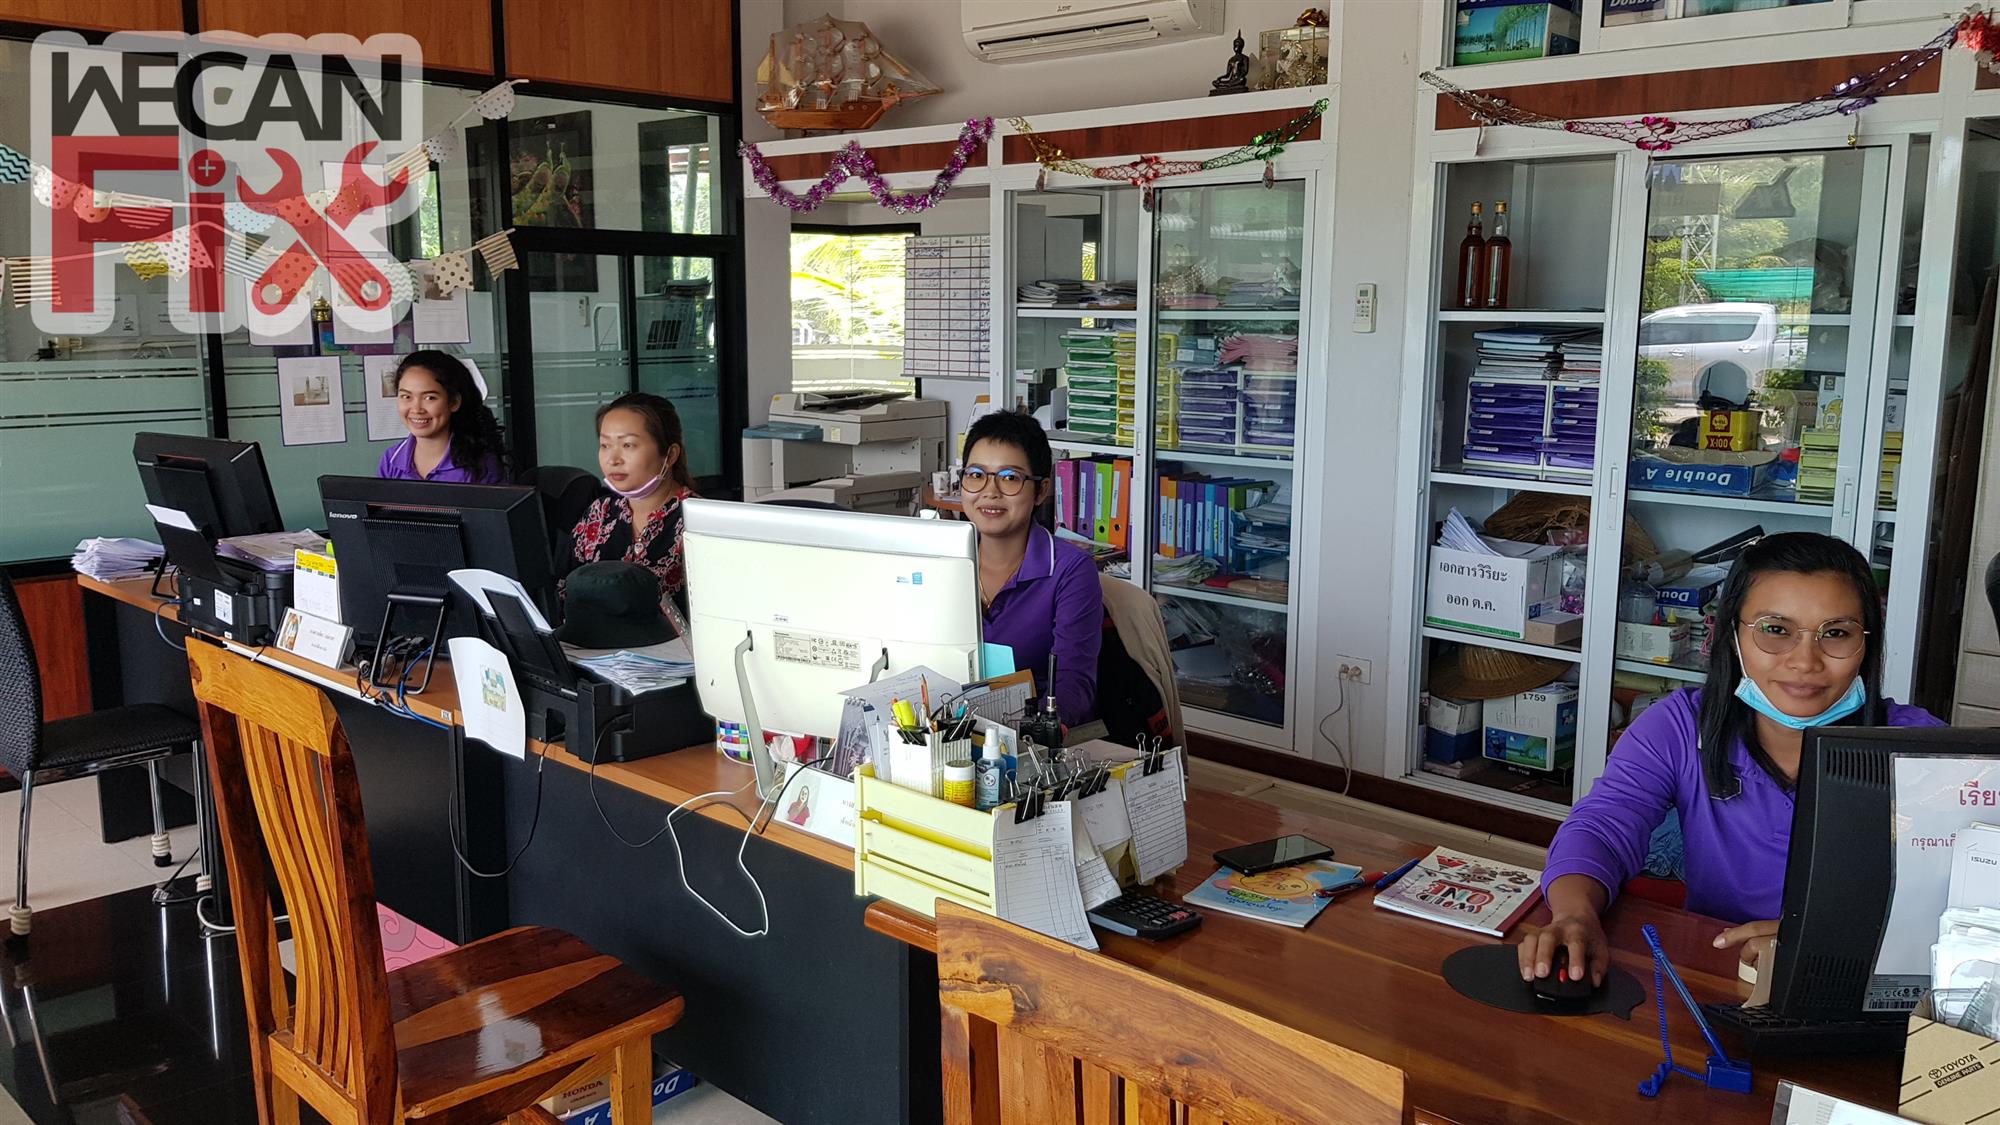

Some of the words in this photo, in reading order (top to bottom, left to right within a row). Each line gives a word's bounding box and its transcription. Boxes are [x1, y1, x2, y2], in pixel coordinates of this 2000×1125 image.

[1708, 436, 1729, 449] X-100
[1646, 467, 1659, 481] A
[1665, 469, 1732, 486] Double
[329, 511, 358, 520] lenovo
[1446, 593, 1469, 607] ออก
[1522, 692, 1547, 703] 1759
[1959, 780, 2000, 806] เรีย
[1970, 856, 1998, 866] ISUZU
[1940, 1054, 1978, 1073] TOYOTA
[1936, 1070, 1963, 1087] GENUINE
[562, 1081, 604, 1099] HONDA
